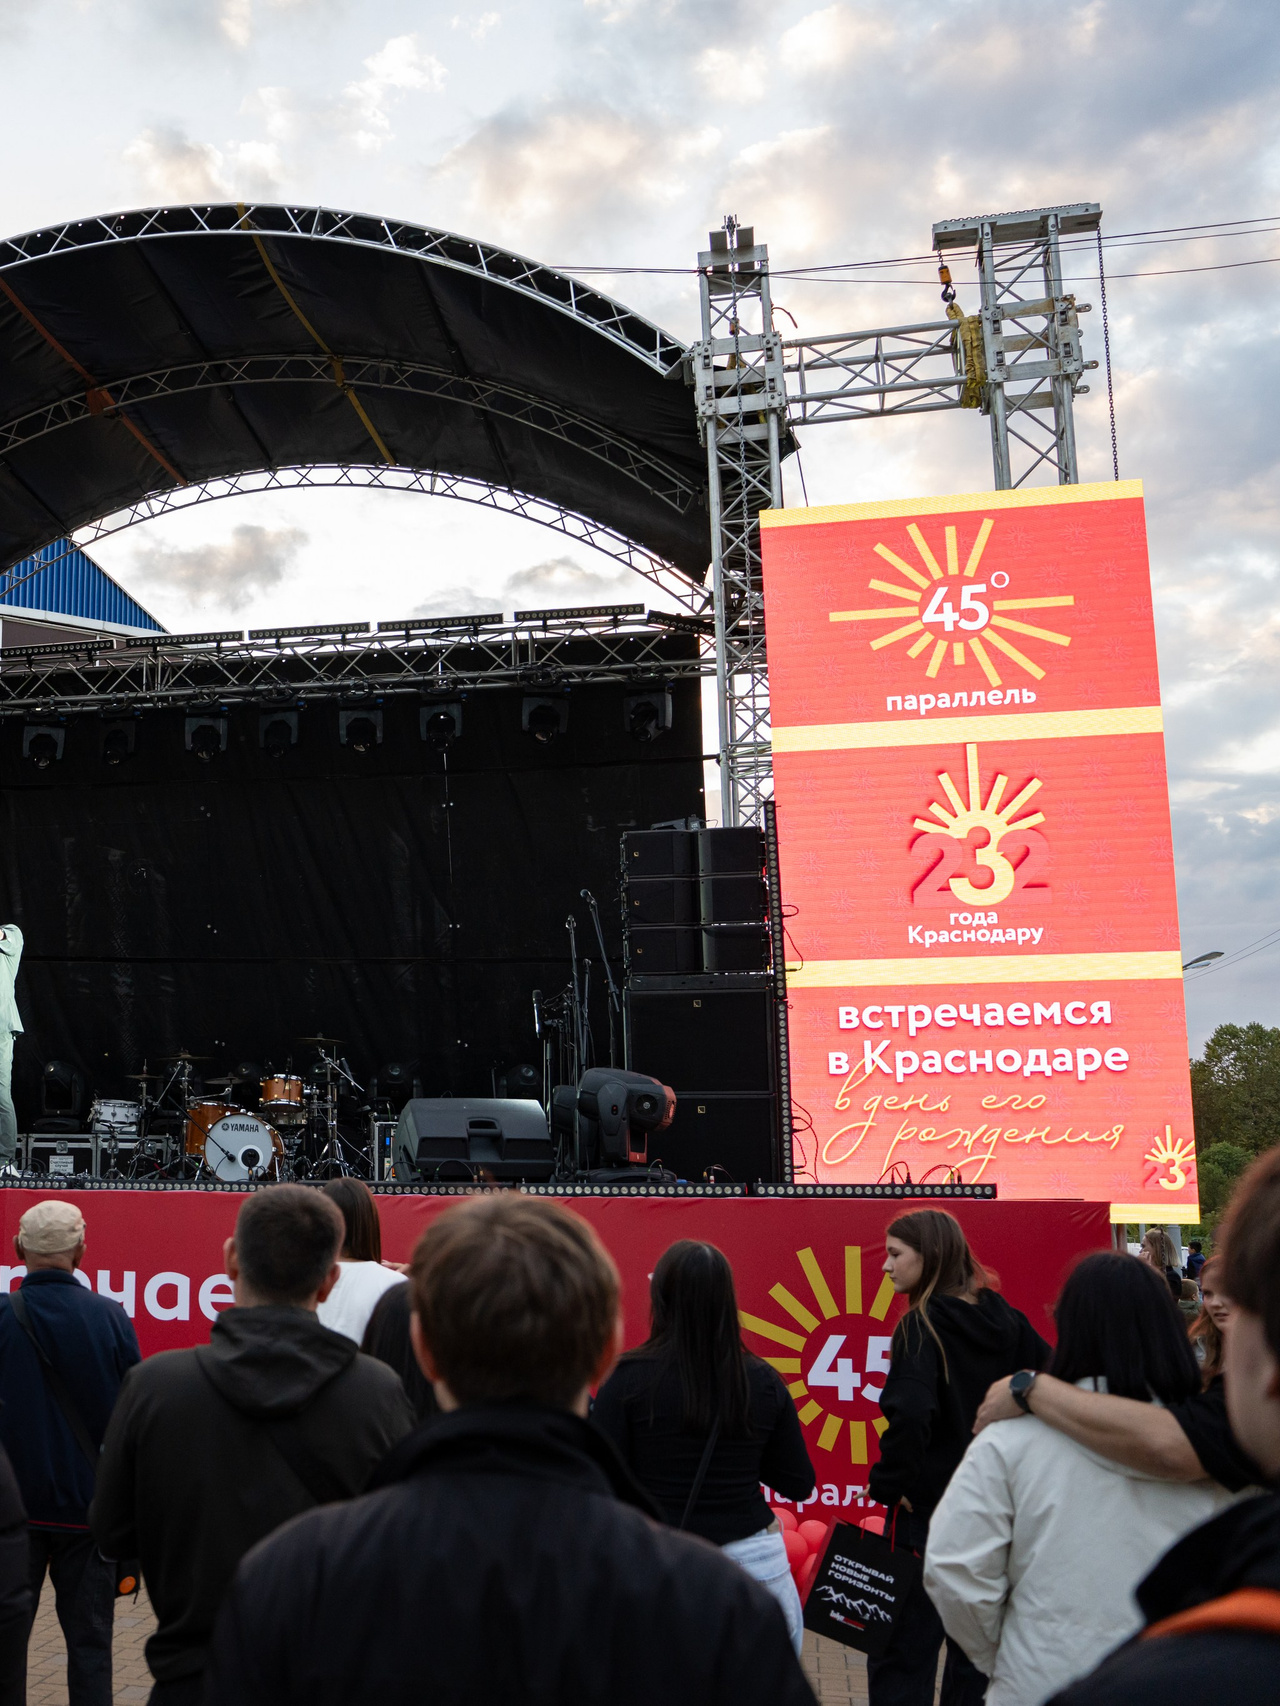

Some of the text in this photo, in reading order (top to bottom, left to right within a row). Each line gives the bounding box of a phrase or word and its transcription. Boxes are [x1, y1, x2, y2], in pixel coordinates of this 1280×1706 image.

[886, 688, 1037, 715] параллель
[910, 828, 1053, 908] 232
[949, 911, 999, 927] года
[907, 925, 1044, 948] Краснодару
[838, 1000, 1113, 1036] встречаемся
[828, 1040, 1129, 1082] в Краснодаре
[230, 1123, 259, 1132] YAMAHA
[822, 1093, 951, 1165] день
[981, 1094, 1046, 1110] его
[880, 1119, 1124, 1184] рождения
[807, 1334, 892, 1403] 45
[831, 1562, 870, 1582] НОВЫЕ
[834, 1554, 894, 1584] ОТКРЫВАЙ
[828, 1570, 895, 1602] ГОРИЗОНТЫ
